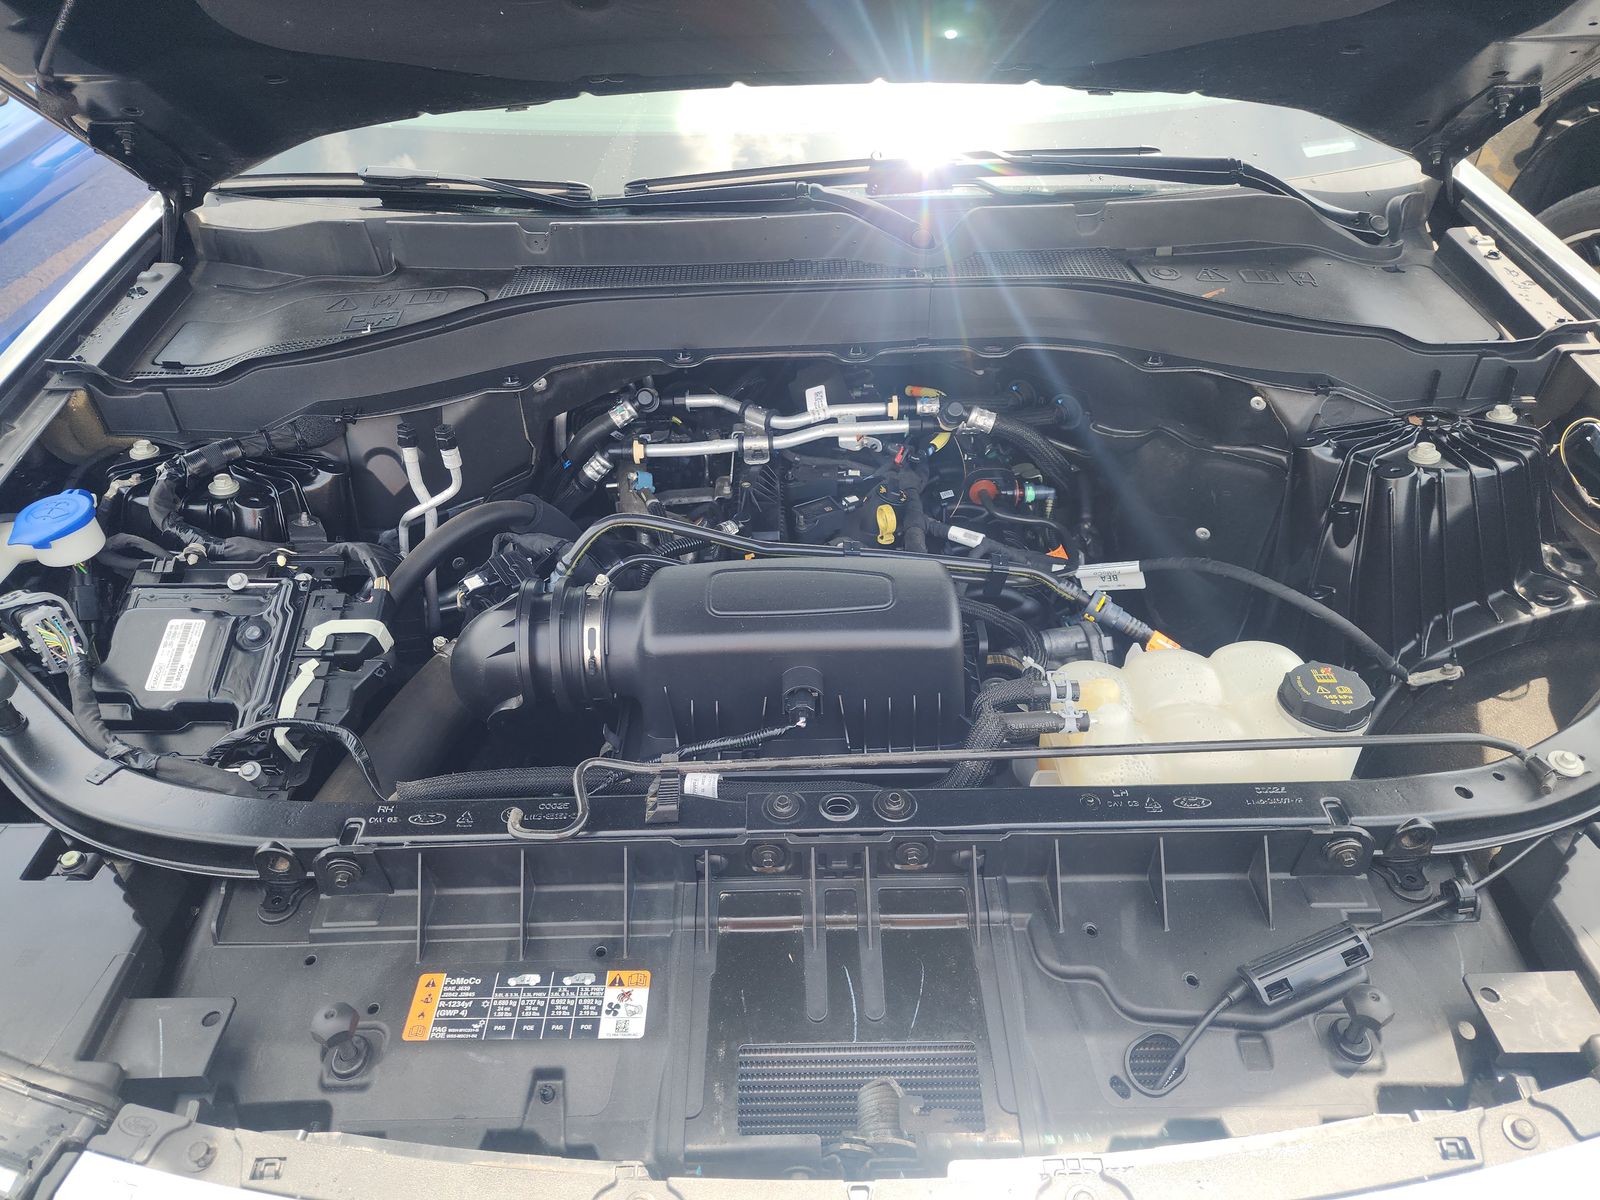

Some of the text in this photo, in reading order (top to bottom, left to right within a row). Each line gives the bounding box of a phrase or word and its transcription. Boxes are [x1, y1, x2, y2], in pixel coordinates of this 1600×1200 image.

[175, 664, 184, 681] BOSCH
[445, 977, 482, 985] FoMoCo
[439, 1001, 473, 1009] R-1234yf
